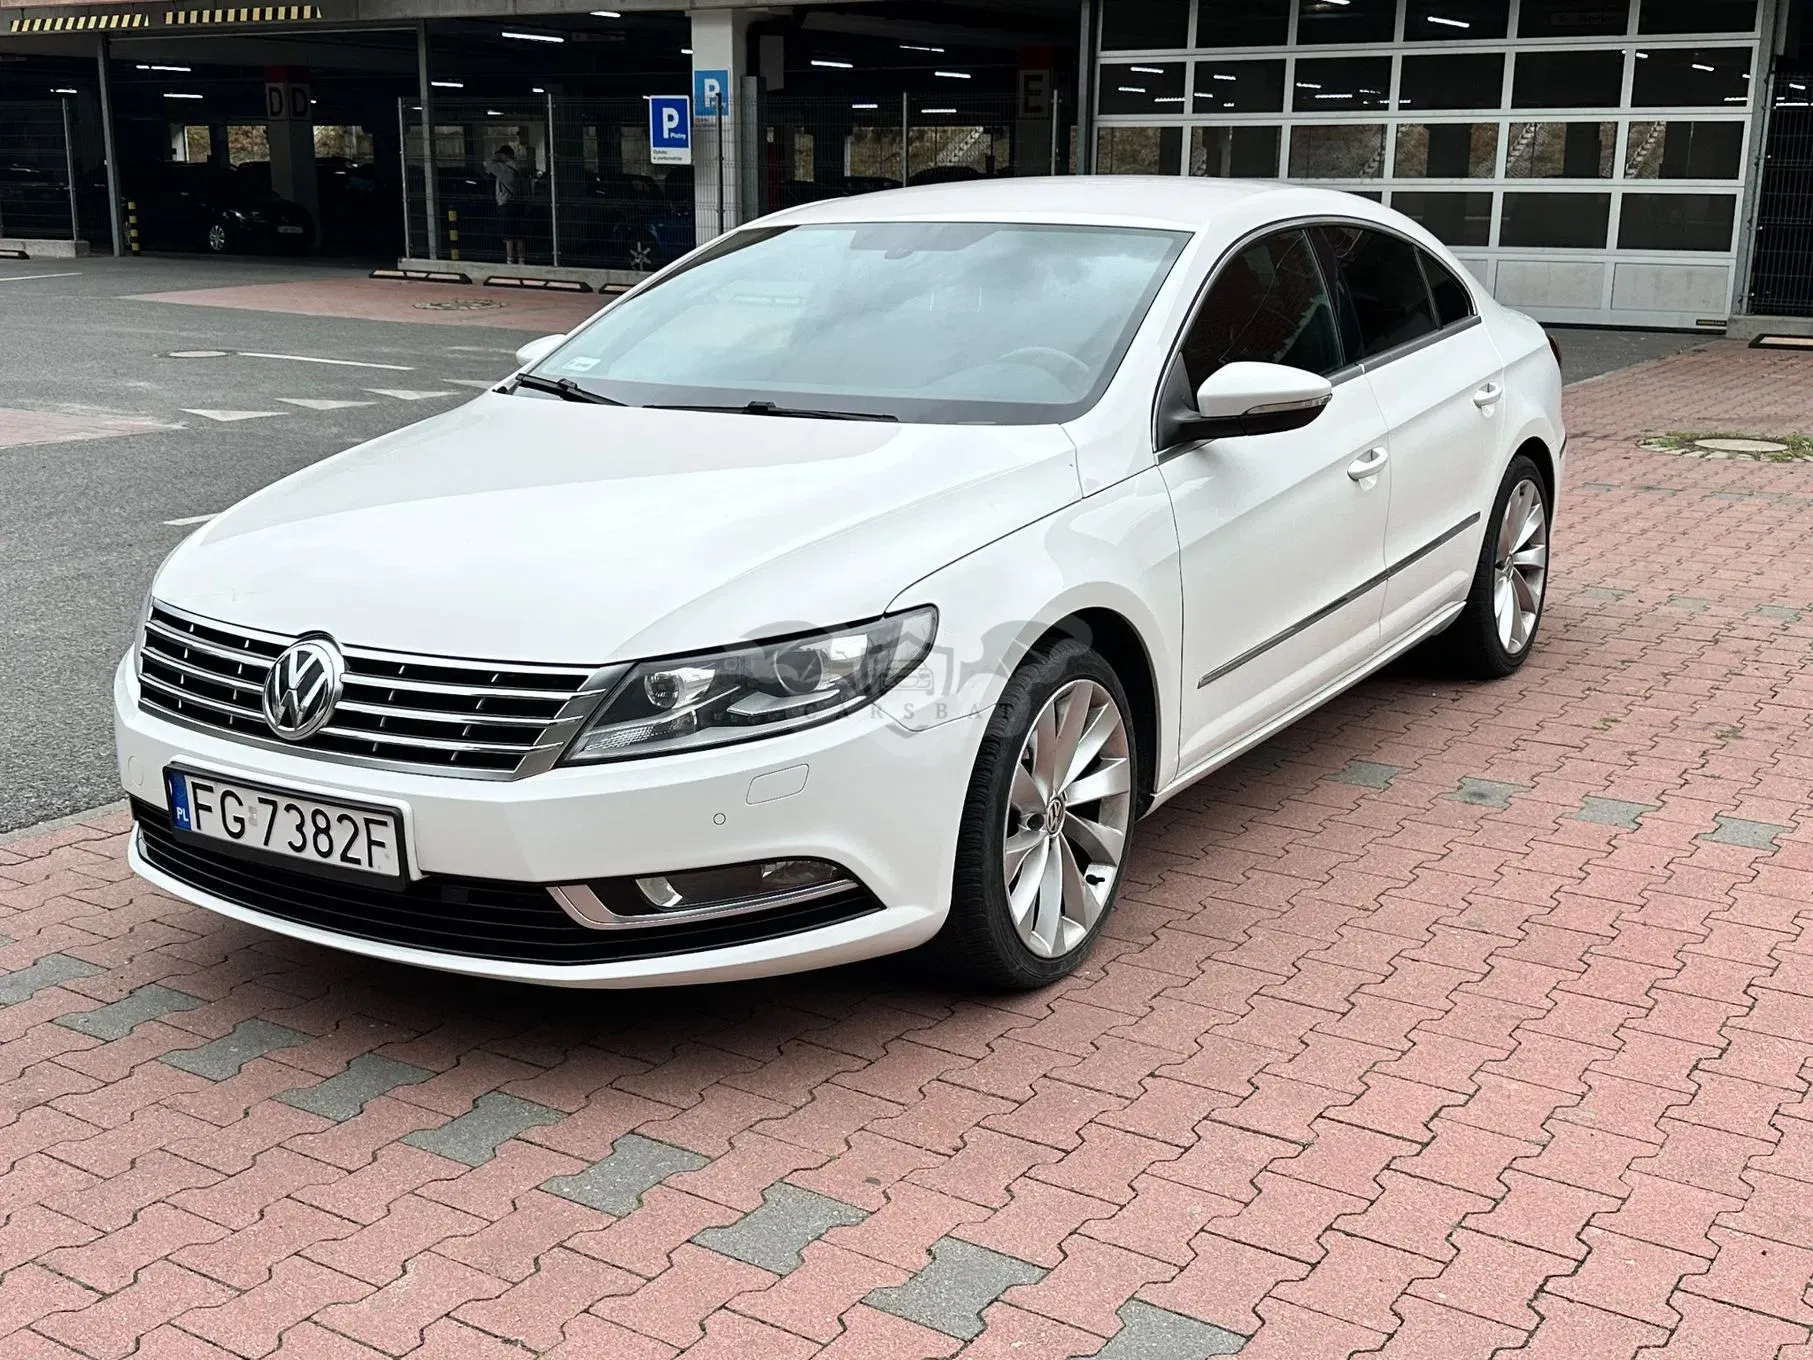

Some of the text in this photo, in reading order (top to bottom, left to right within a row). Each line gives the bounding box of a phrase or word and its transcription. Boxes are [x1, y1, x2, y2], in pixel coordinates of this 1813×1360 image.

[269, 87, 282, 116] D
[292, 87, 307, 116] D
[704, 78, 720, 108] P
[1024, 75, 1042, 113] E
[662, 107, 679, 139] P
[176, 806, 190, 822] PL
[191, 780, 389, 868] FG 7382F
